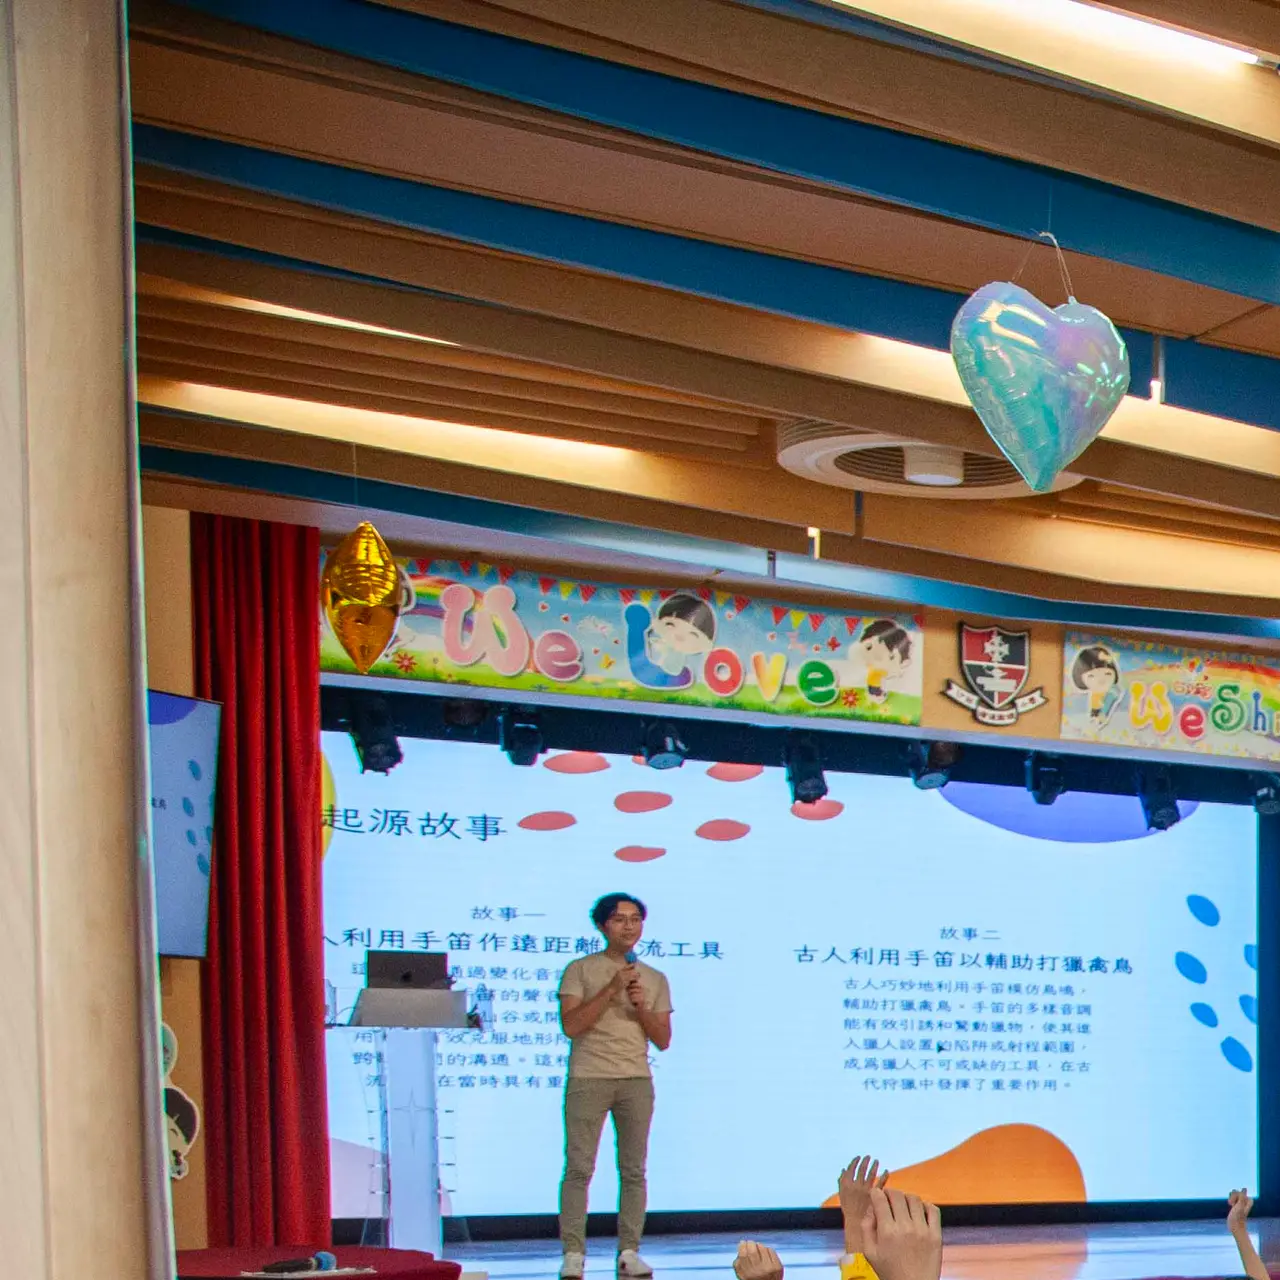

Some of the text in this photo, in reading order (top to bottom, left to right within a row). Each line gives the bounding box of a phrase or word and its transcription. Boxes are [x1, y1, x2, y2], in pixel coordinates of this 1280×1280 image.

[440, 584, 839, 706] We Love
[1129, 681, 1207, 741] We
[471, 905, 548, 922] 故事一
[940, 926, 1001, 941] 故事二
[794, 944, 1133, 974] 古人利用手笛以輔助打獵禽鳥
